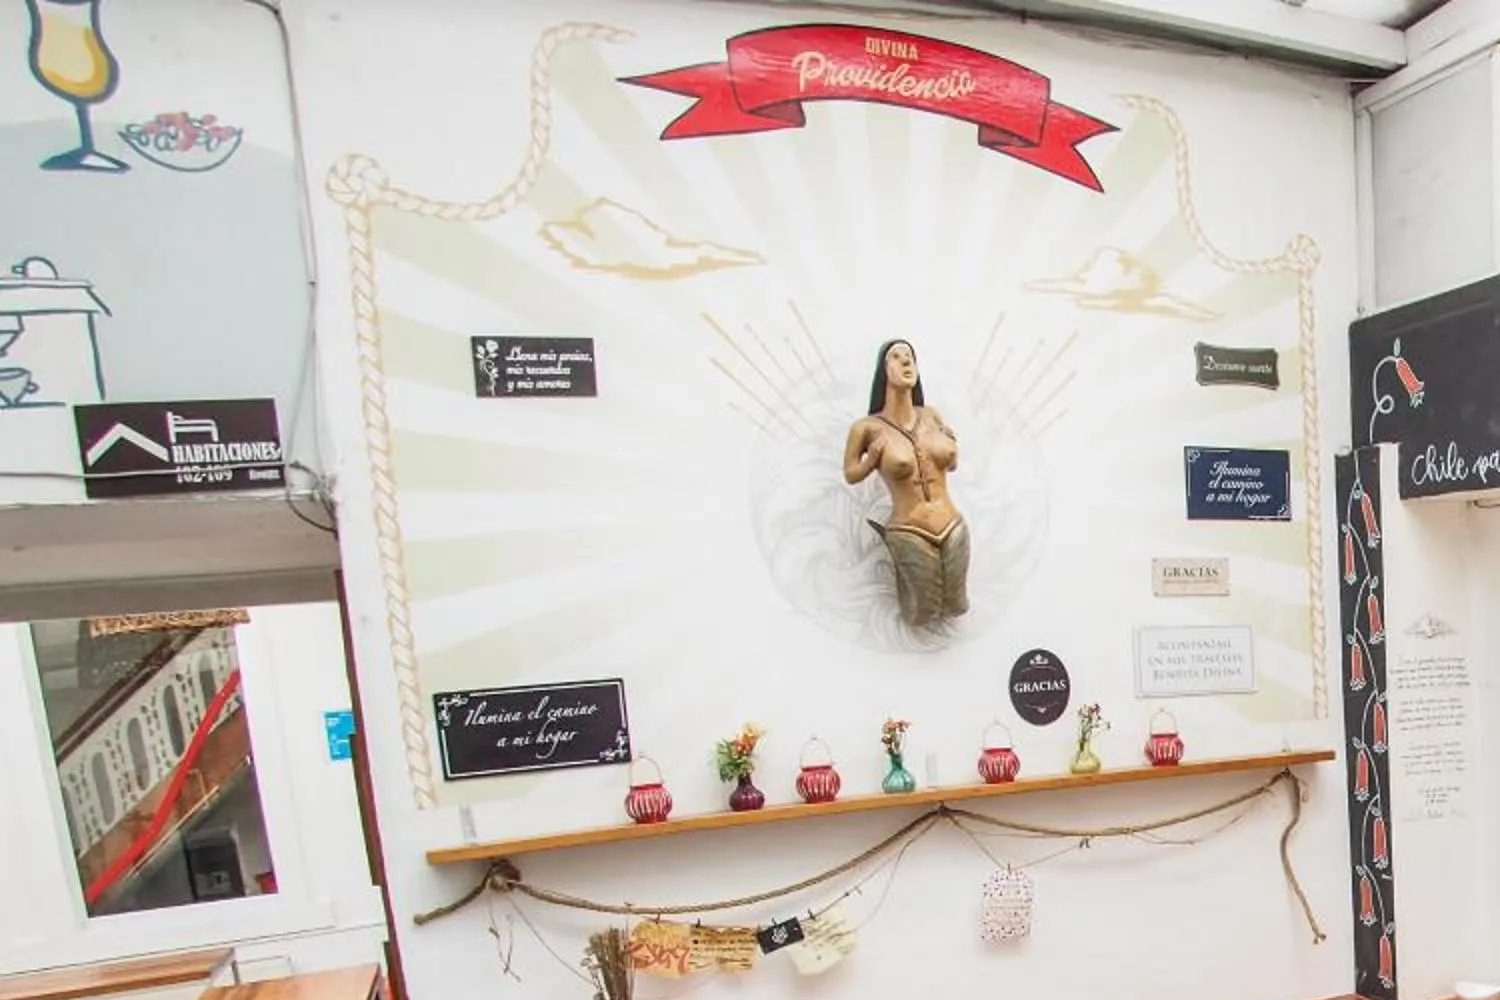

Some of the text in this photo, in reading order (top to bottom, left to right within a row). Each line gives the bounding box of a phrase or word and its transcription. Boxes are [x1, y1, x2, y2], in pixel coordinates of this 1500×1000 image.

[864, 36, 919, 60] DIVINA
[791, 51, 976, 100] Providencia
[1411, 440, 1469, 486] Chile
[1235, 487, 1271, 508] hogar
[1163, 566, 1219, 578] GRACIAS
[1014, 680, 1066, 693] GRACIAS
[464, 695, 599, 727] Ilumina el camino
[496, 720, 578, 759] a mi hogar
